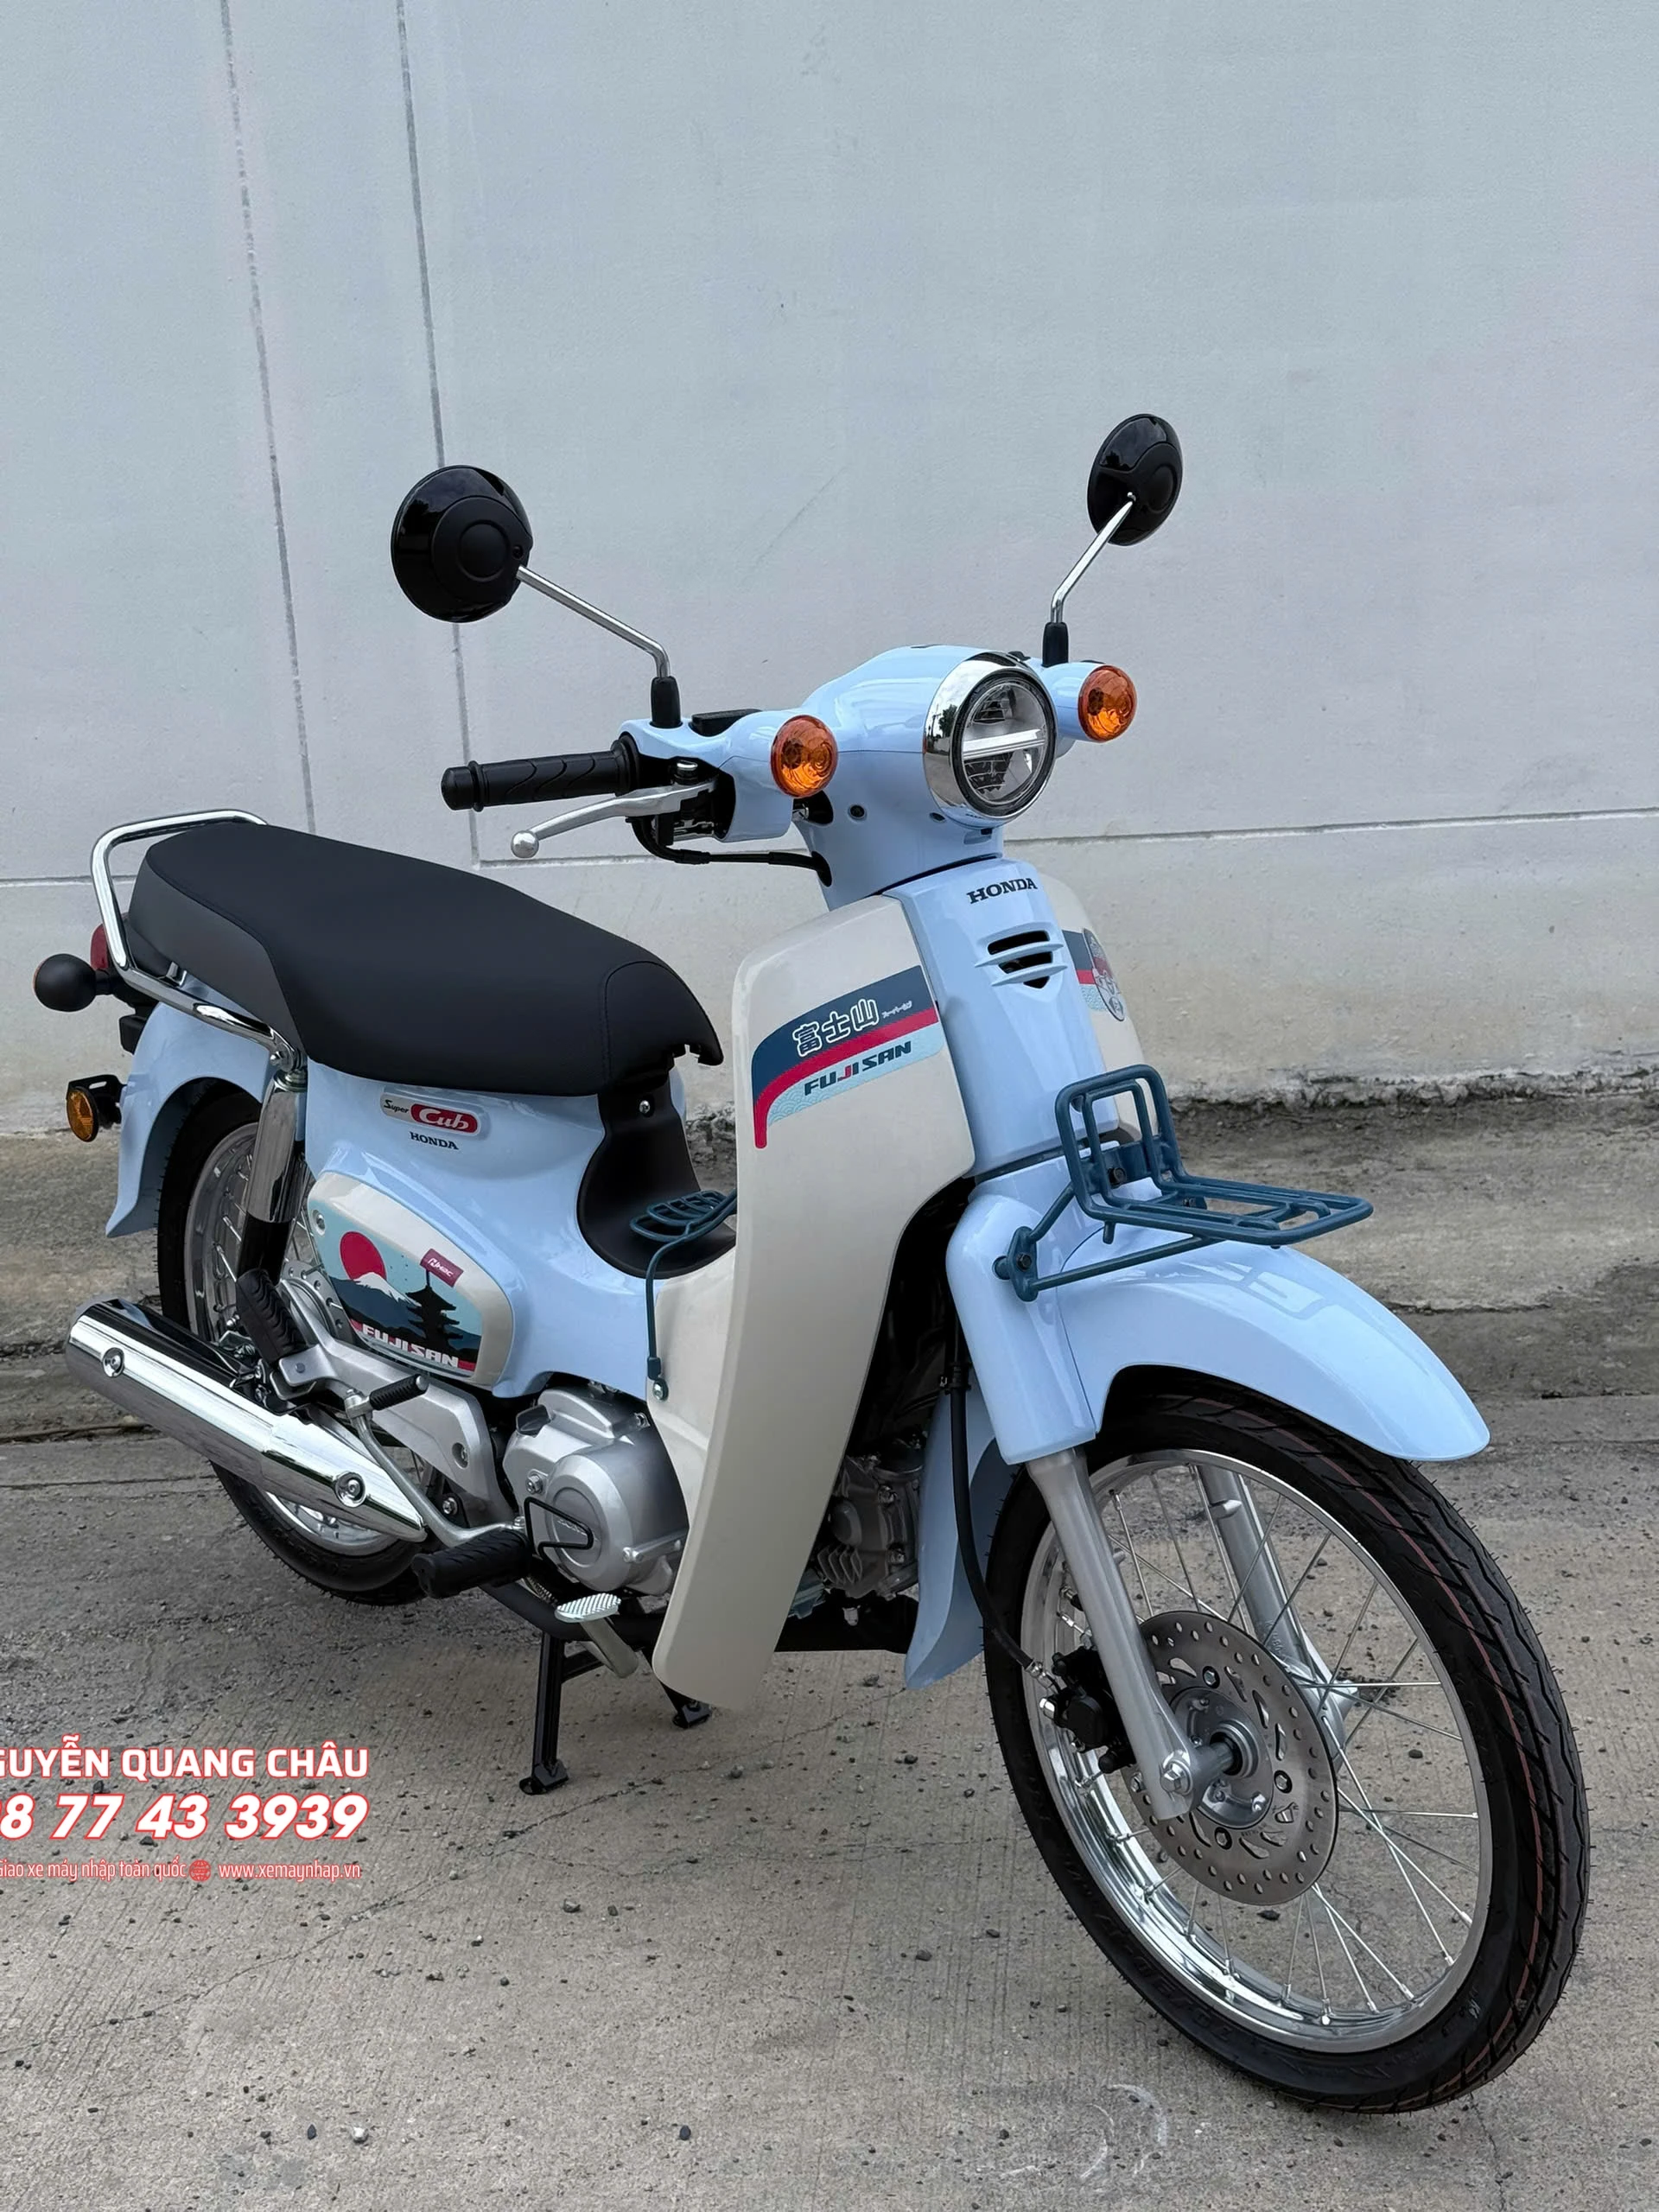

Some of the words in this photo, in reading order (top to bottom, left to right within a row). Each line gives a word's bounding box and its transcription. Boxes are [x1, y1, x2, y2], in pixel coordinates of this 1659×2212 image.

[966, 878, 1038, 904] HONDA
[791, 998, 880, 1057] 富士山
[804, 1041, 912, 1096] FUJISAN
[384, 1099, 409, 1113] Super
[419, 1108, 469, 1129] Cub
[410, 1131, 459, 1150] HONDA
[363, 1323, 459, 1368] FUJISAN
